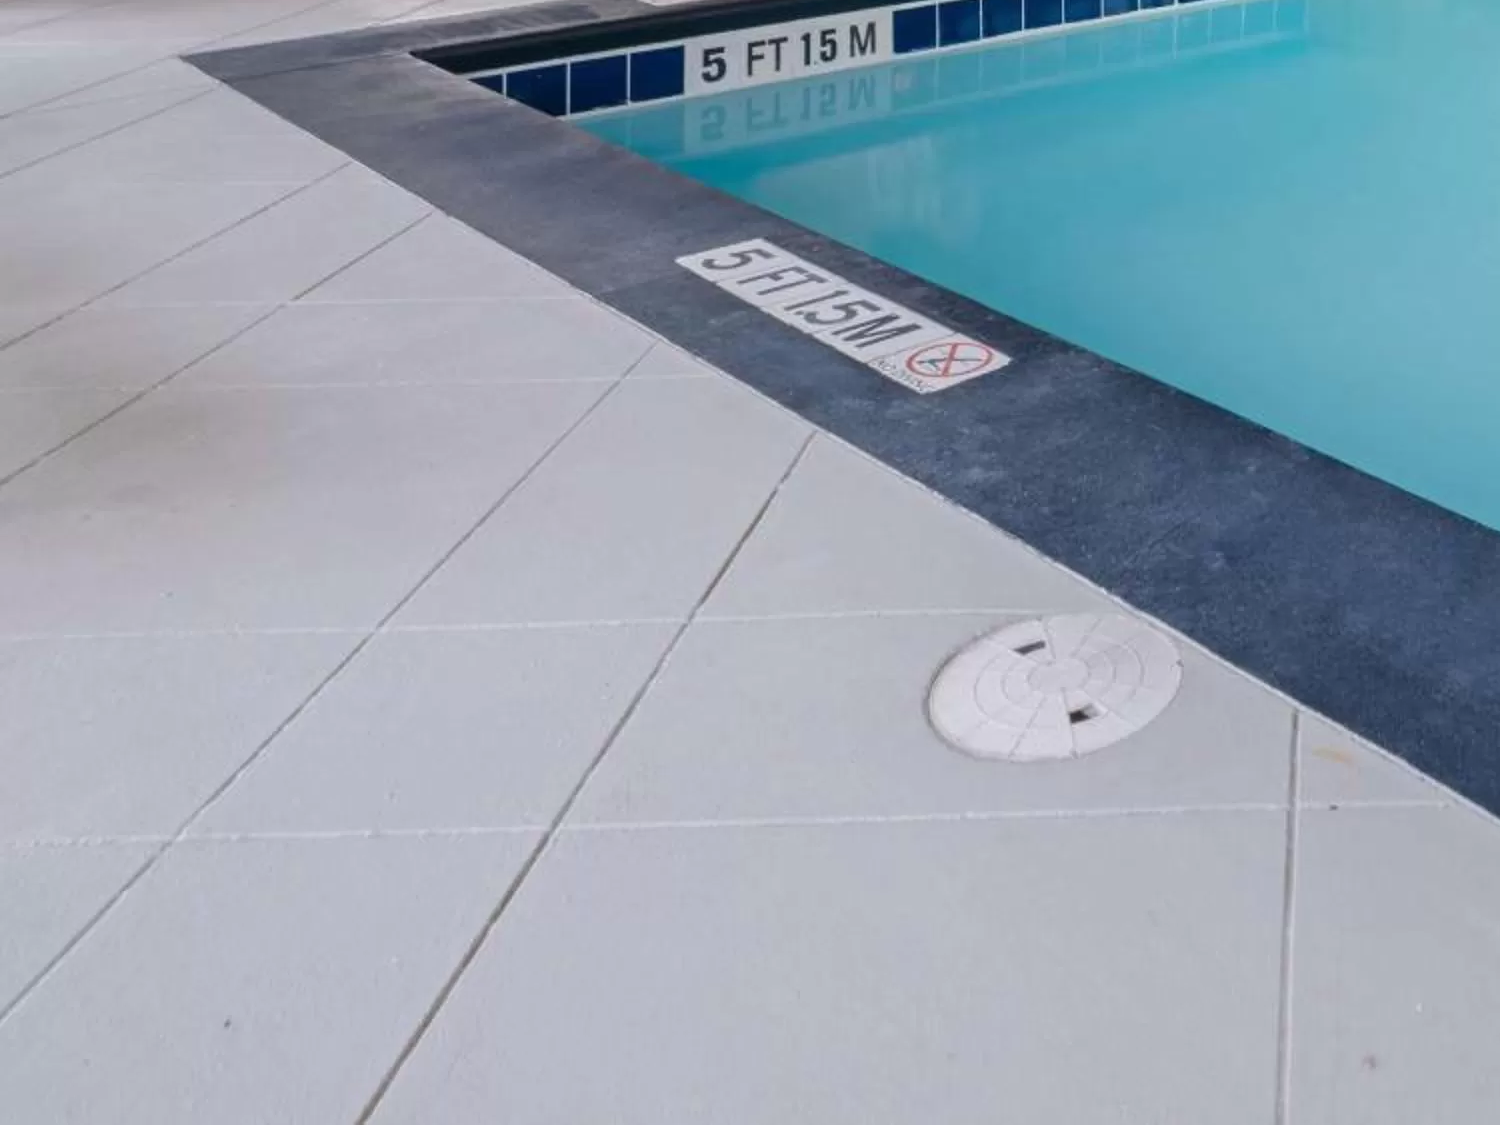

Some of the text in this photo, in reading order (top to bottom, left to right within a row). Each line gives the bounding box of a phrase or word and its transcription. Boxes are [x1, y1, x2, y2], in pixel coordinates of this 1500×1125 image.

[701, 46, 727, 83] 5
[747, 36, 788, 77] FT
[849, 22, 877, 57] M
[701, 249, 775, 271] 5
[737, 265, 826, 296] FT
[831, 314, 921, 349] M
